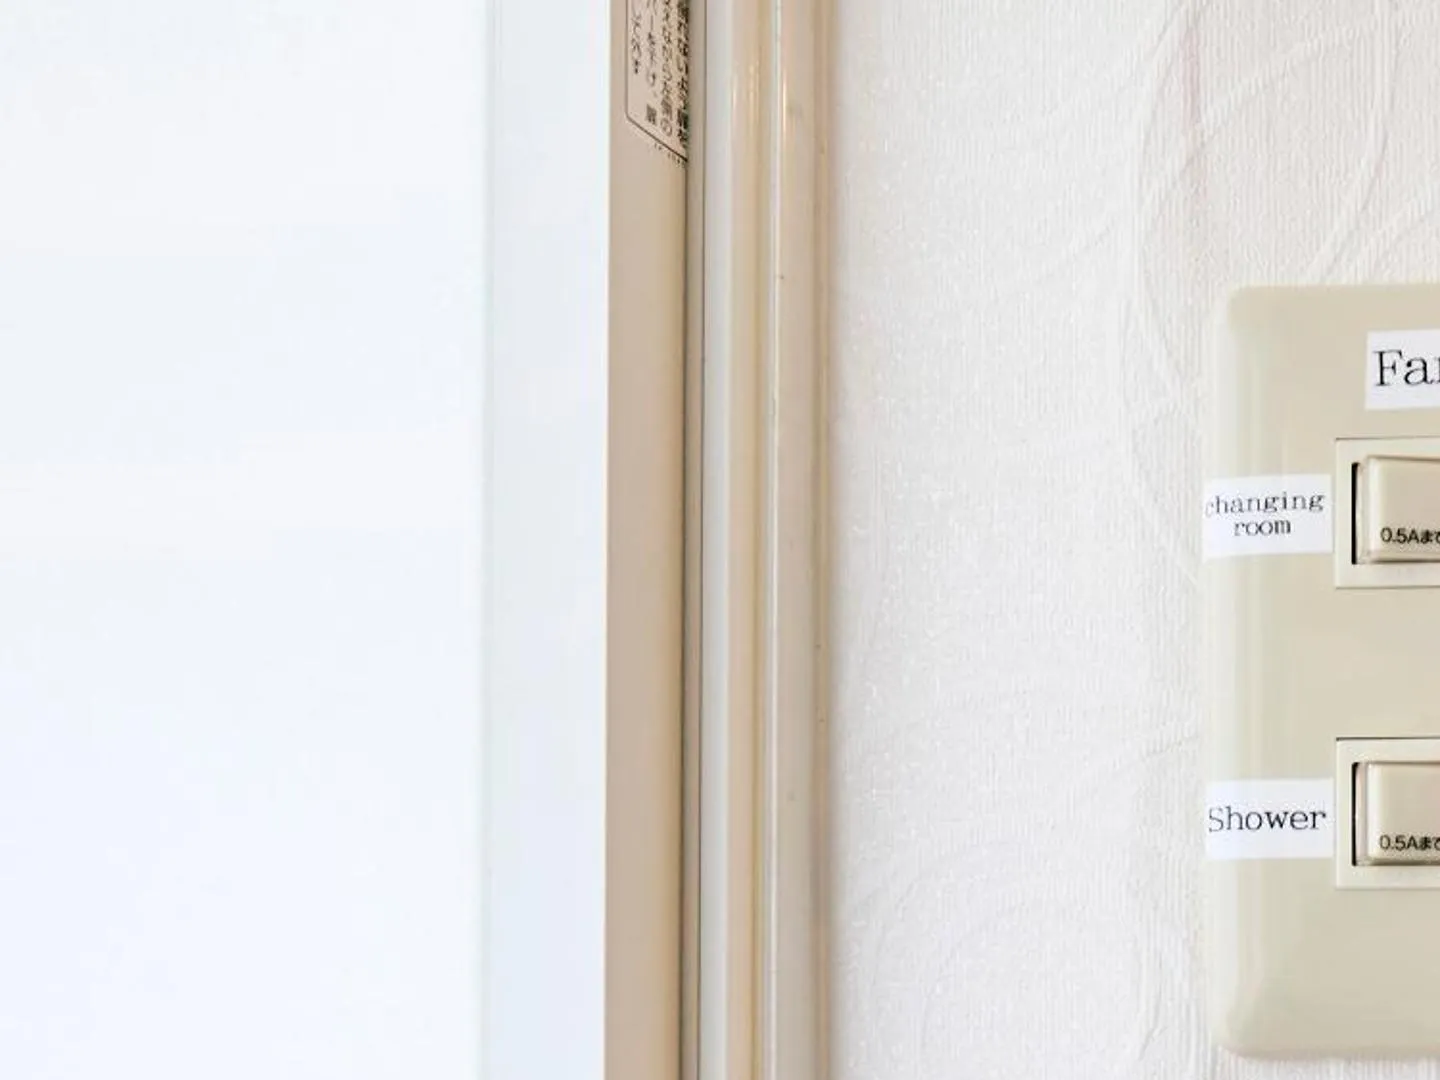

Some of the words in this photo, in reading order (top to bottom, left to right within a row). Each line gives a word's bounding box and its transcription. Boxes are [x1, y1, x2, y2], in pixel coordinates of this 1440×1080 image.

[1205, 490, 1325, 518] changing
[1234, 519, 1291, 536] room
[1208, 806, 1327, 834] Shower
